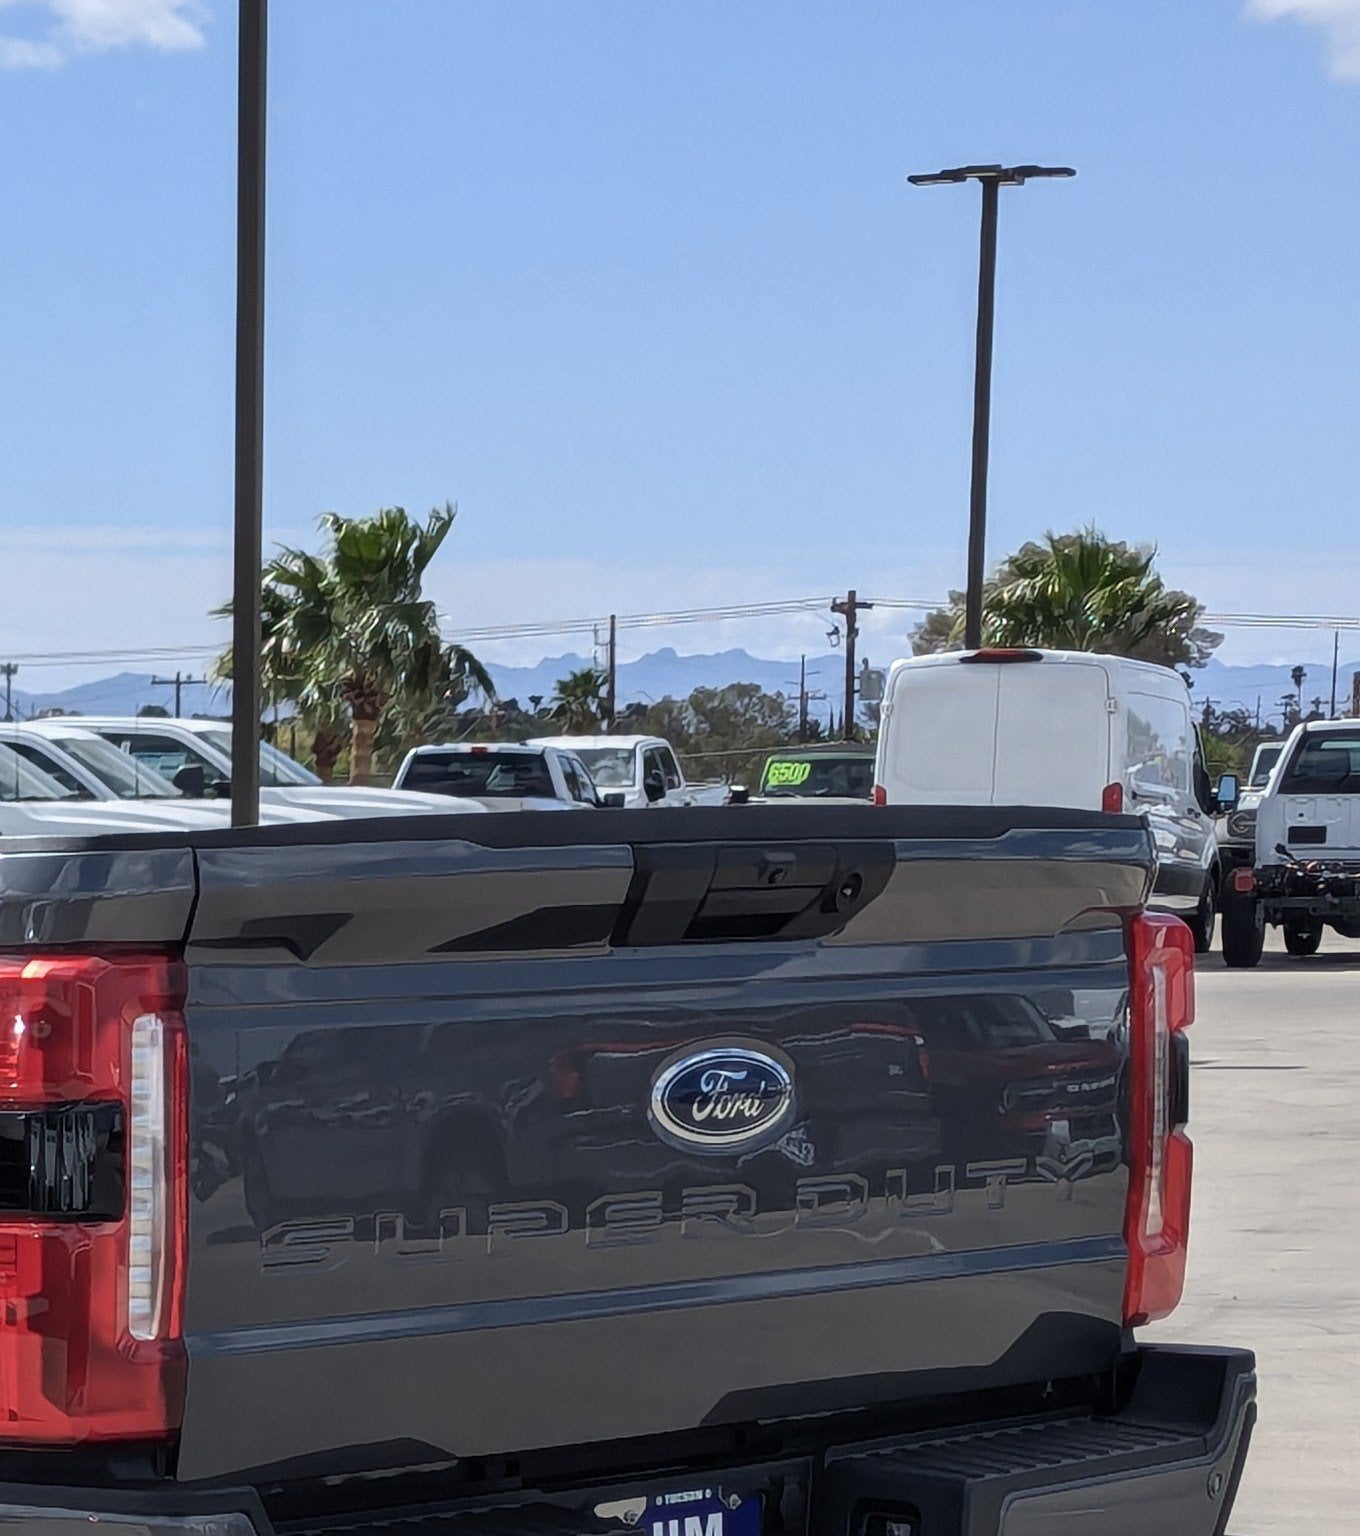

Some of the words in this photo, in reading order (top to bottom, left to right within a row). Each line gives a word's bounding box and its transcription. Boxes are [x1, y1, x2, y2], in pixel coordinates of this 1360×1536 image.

[691, 1068, 766, 1121] Ford
[261, 1183, 756, 1275] SUPER
[795, 1156, 1095, 1227] DUTY
